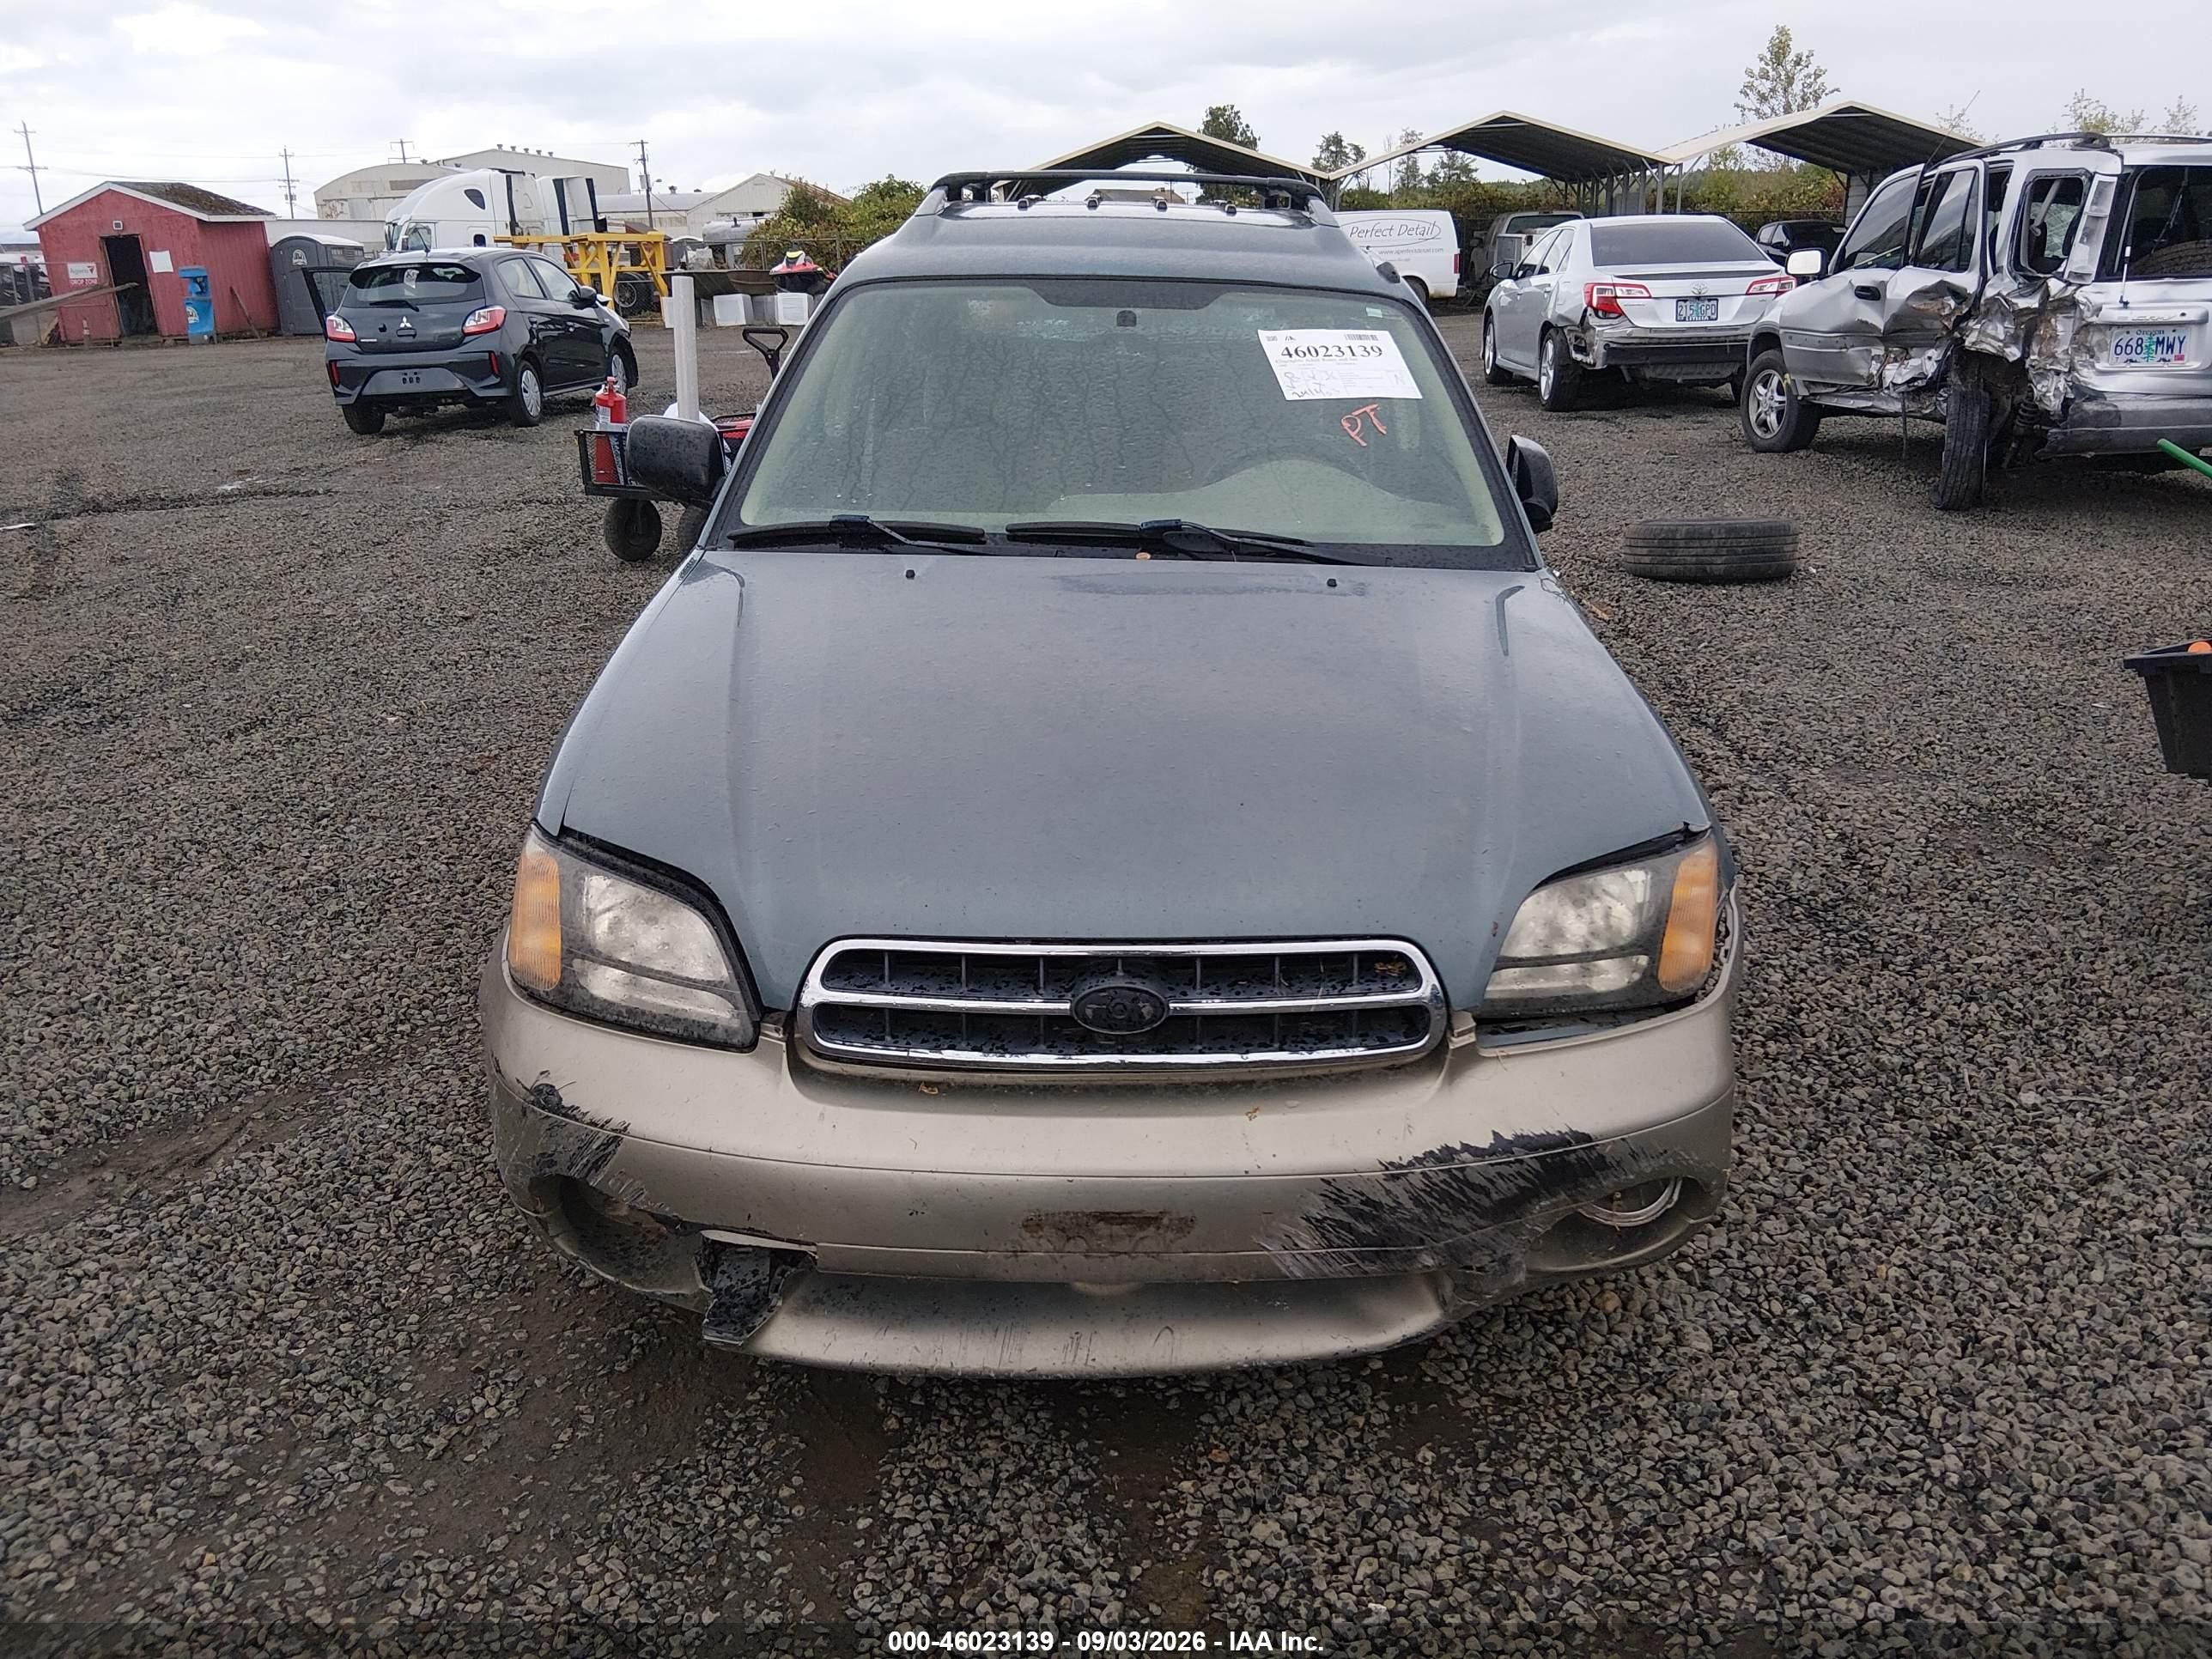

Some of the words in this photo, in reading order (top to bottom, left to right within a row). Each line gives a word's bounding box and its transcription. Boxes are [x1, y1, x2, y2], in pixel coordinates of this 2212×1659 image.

[1349, 222, 1395, 238] Perfect
[1397, 221, 1437, 237] Detail
[1678, 304, 1694, 317] 215
[1280, 344, 1383, 359] 46023139
[2114, 337, 2144, 356] 668
[2154, 336, 2186, 355] MWY
[1340, 404, 1387, 447] PT
